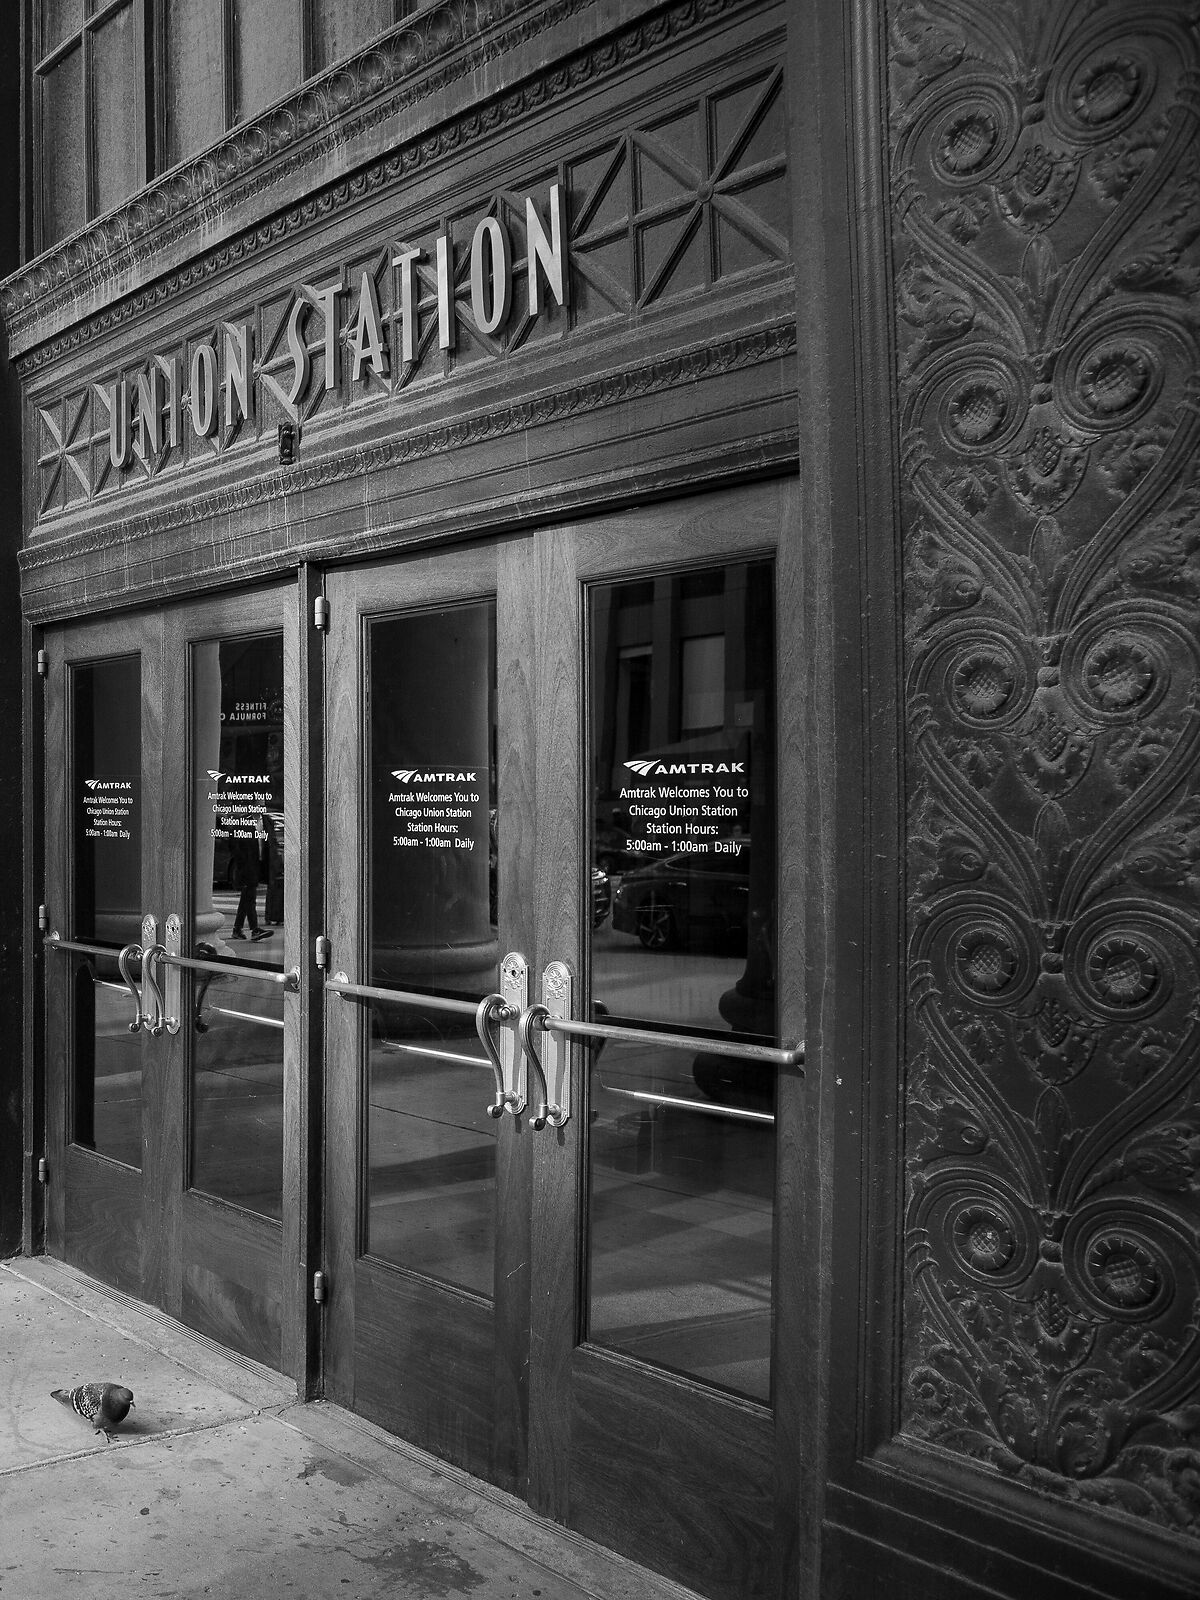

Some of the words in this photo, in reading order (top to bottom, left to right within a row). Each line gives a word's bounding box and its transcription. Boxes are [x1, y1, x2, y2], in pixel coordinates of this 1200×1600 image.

[110, 325, 254, 469] UNION
[287, 184, 570, 404] STATION
[655, 762, 745, 775] AMTRAK
[225, 775, 270, 783] AMTRAK
[413, 772, 477, 783] AMTRAK
[388, 792, 415, 802] Amtrak
[415, 791, 453, 802] Welcomes
[453, 792, 469, 802] You
[470, 792, 480, 802] to
[619, 786, 657, 799] Amtrak
[658, 786, 710, 798] Welcomes
[713, 786, 734, 798] You
[737, 786, 749, 798] to
[395, 807, 422, 819] Chicago
[423, 807, 444, 818] Union
[445, 807, 472, 818] Station
[628, 804, 667, 819] Chicago
[669, 804, 699, 816] Union
[701, 804, 738, 817] Station
[407, 822, 433, 833] Station
[434, 822, 459, 833] Hours:
[646, 822, 682, 834] Station
[685, 822, 719, 835] Hours:
[393, 836, 419, 847] 5:00am
[424, 837, 452, 848] 1:00am
[454, 837, 475, 851] Daily
[626, 839, 662, 851] 5:00am
[671, 840, 709, 853] 1:00am
[714, 841, 742, 857] Daily
